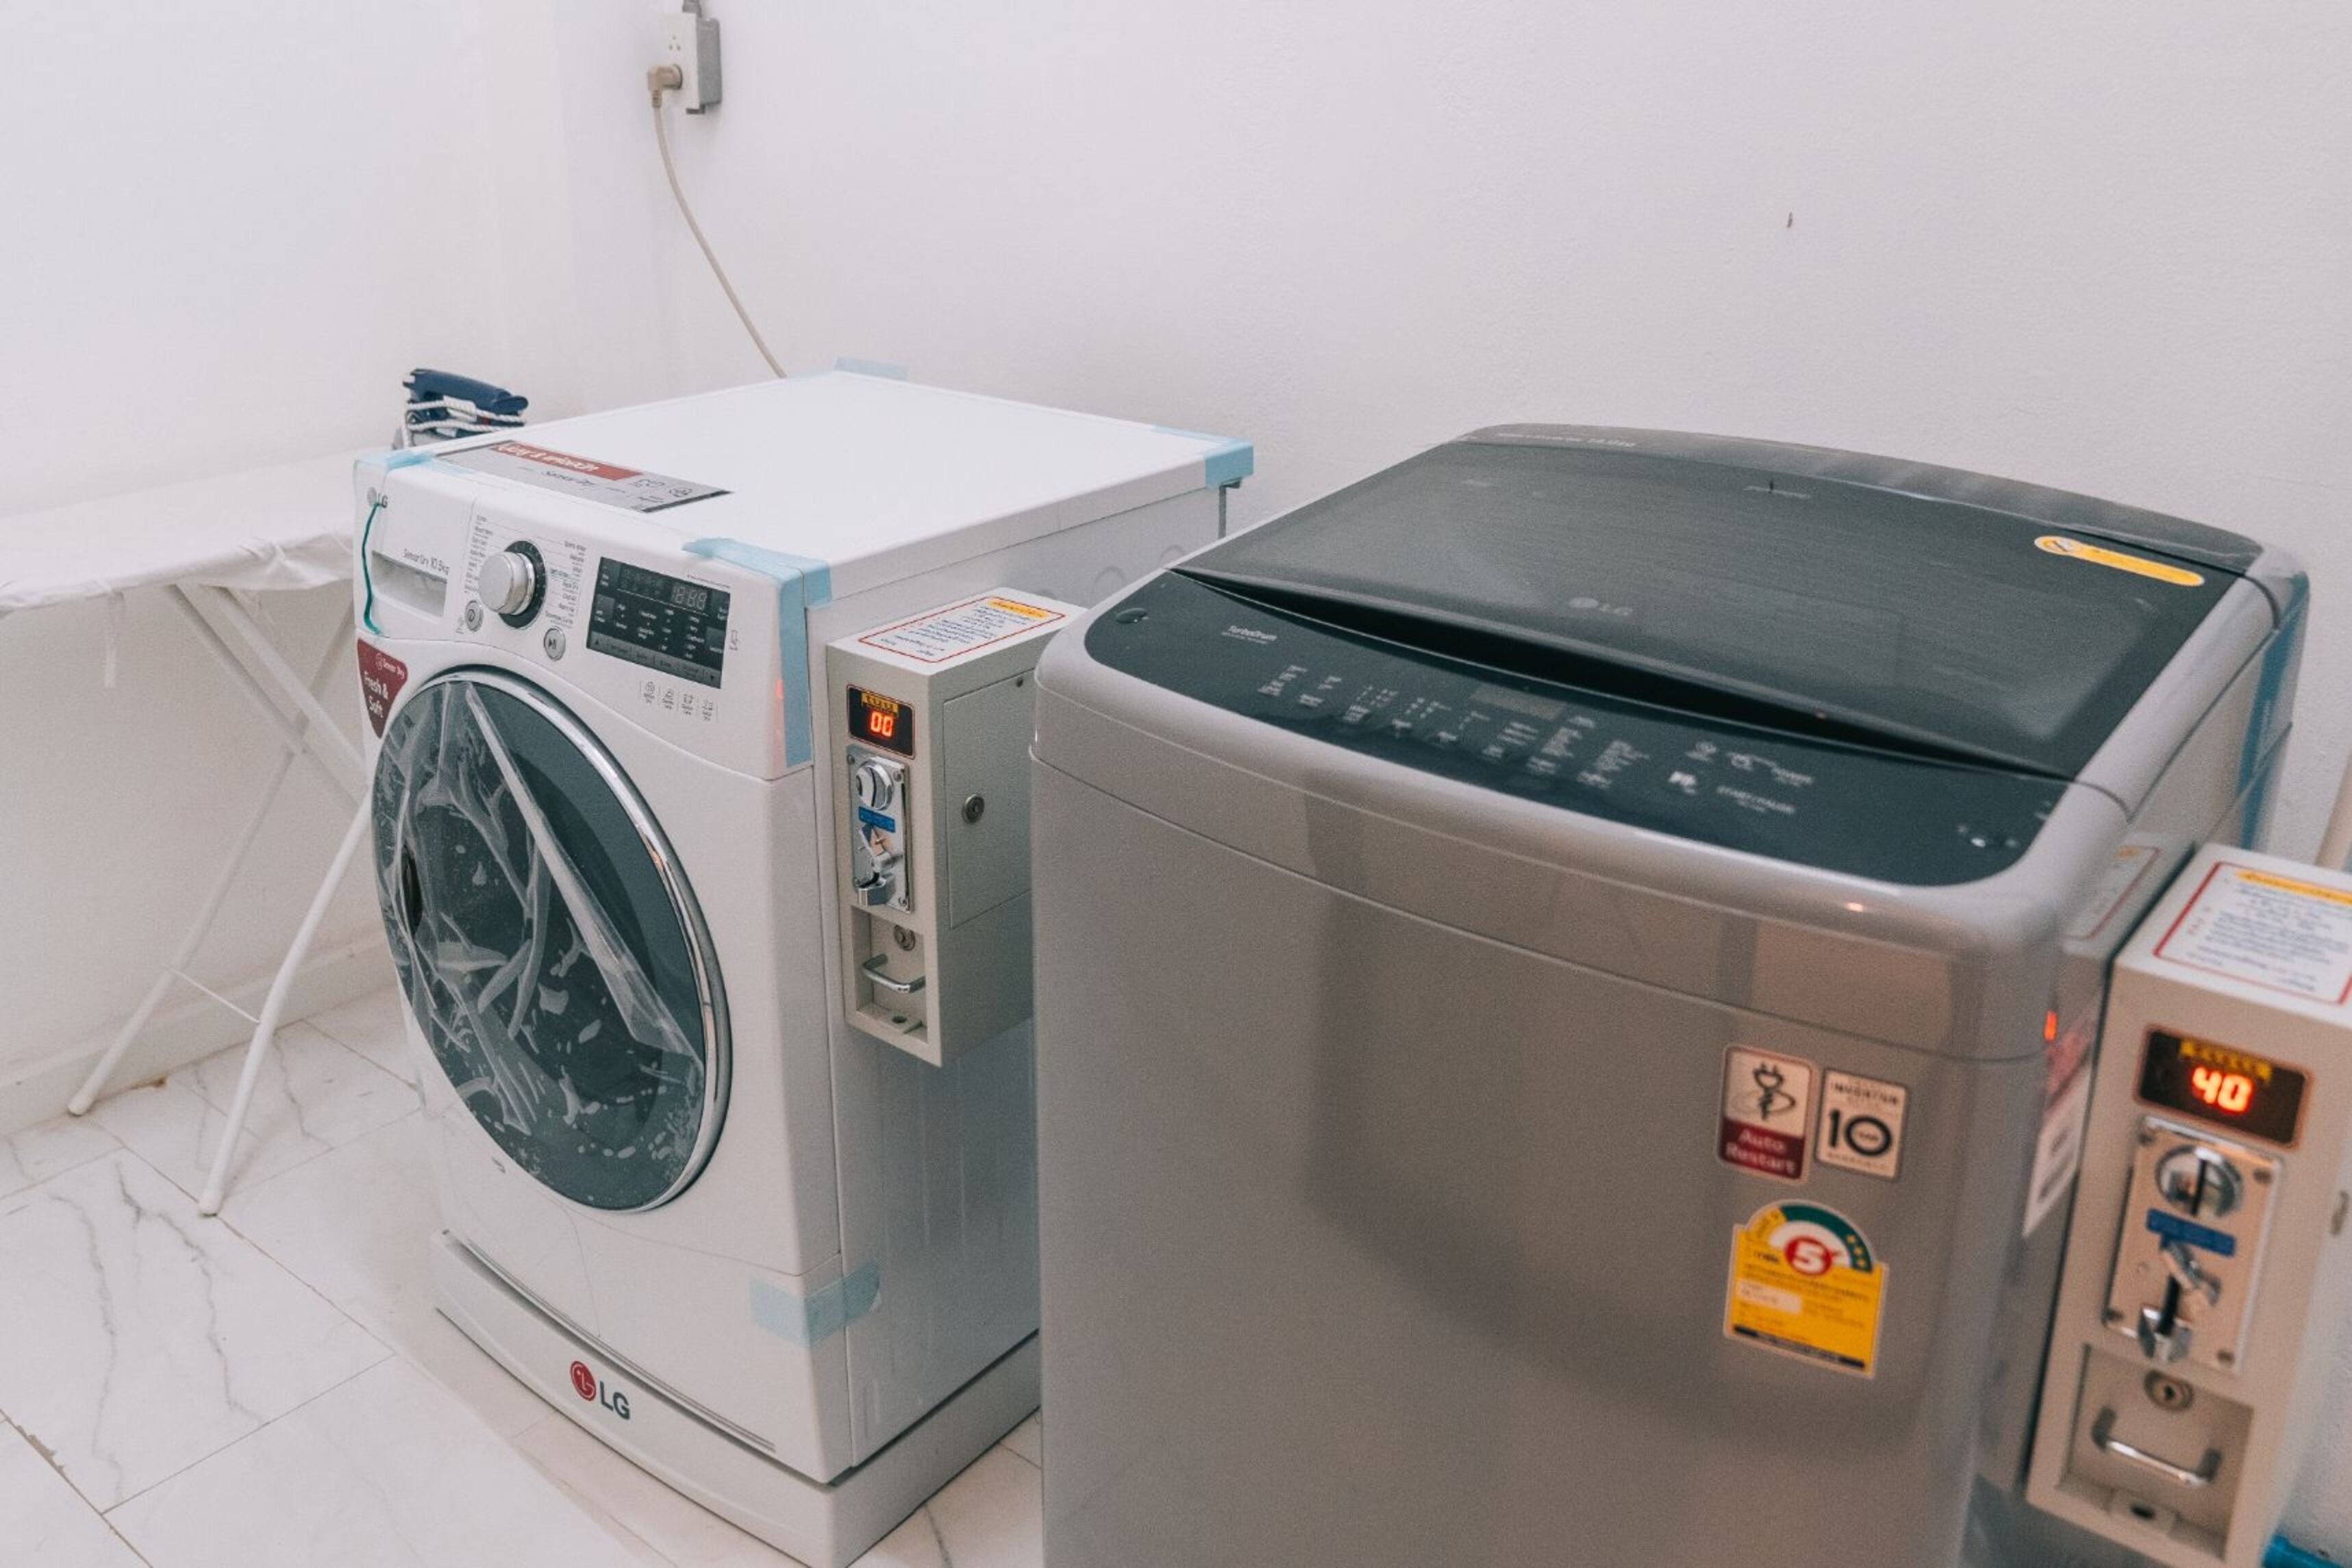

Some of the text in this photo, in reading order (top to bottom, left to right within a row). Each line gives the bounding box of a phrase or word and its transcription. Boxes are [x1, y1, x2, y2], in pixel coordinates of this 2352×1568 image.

[364, 670, 388, 700] Fresh &
[369, 694, 384, 718] Soft
[871, 711, 894, 738] 00
[2192, 1065, 2255, 1113] 40
[1738, 1128, 1787, 1153] Auto
[1827, 1108, 1892, 1158] 10
[1725, 1141, 1795, 1174] Restart
[599, 1380, 630, 1420] LG
